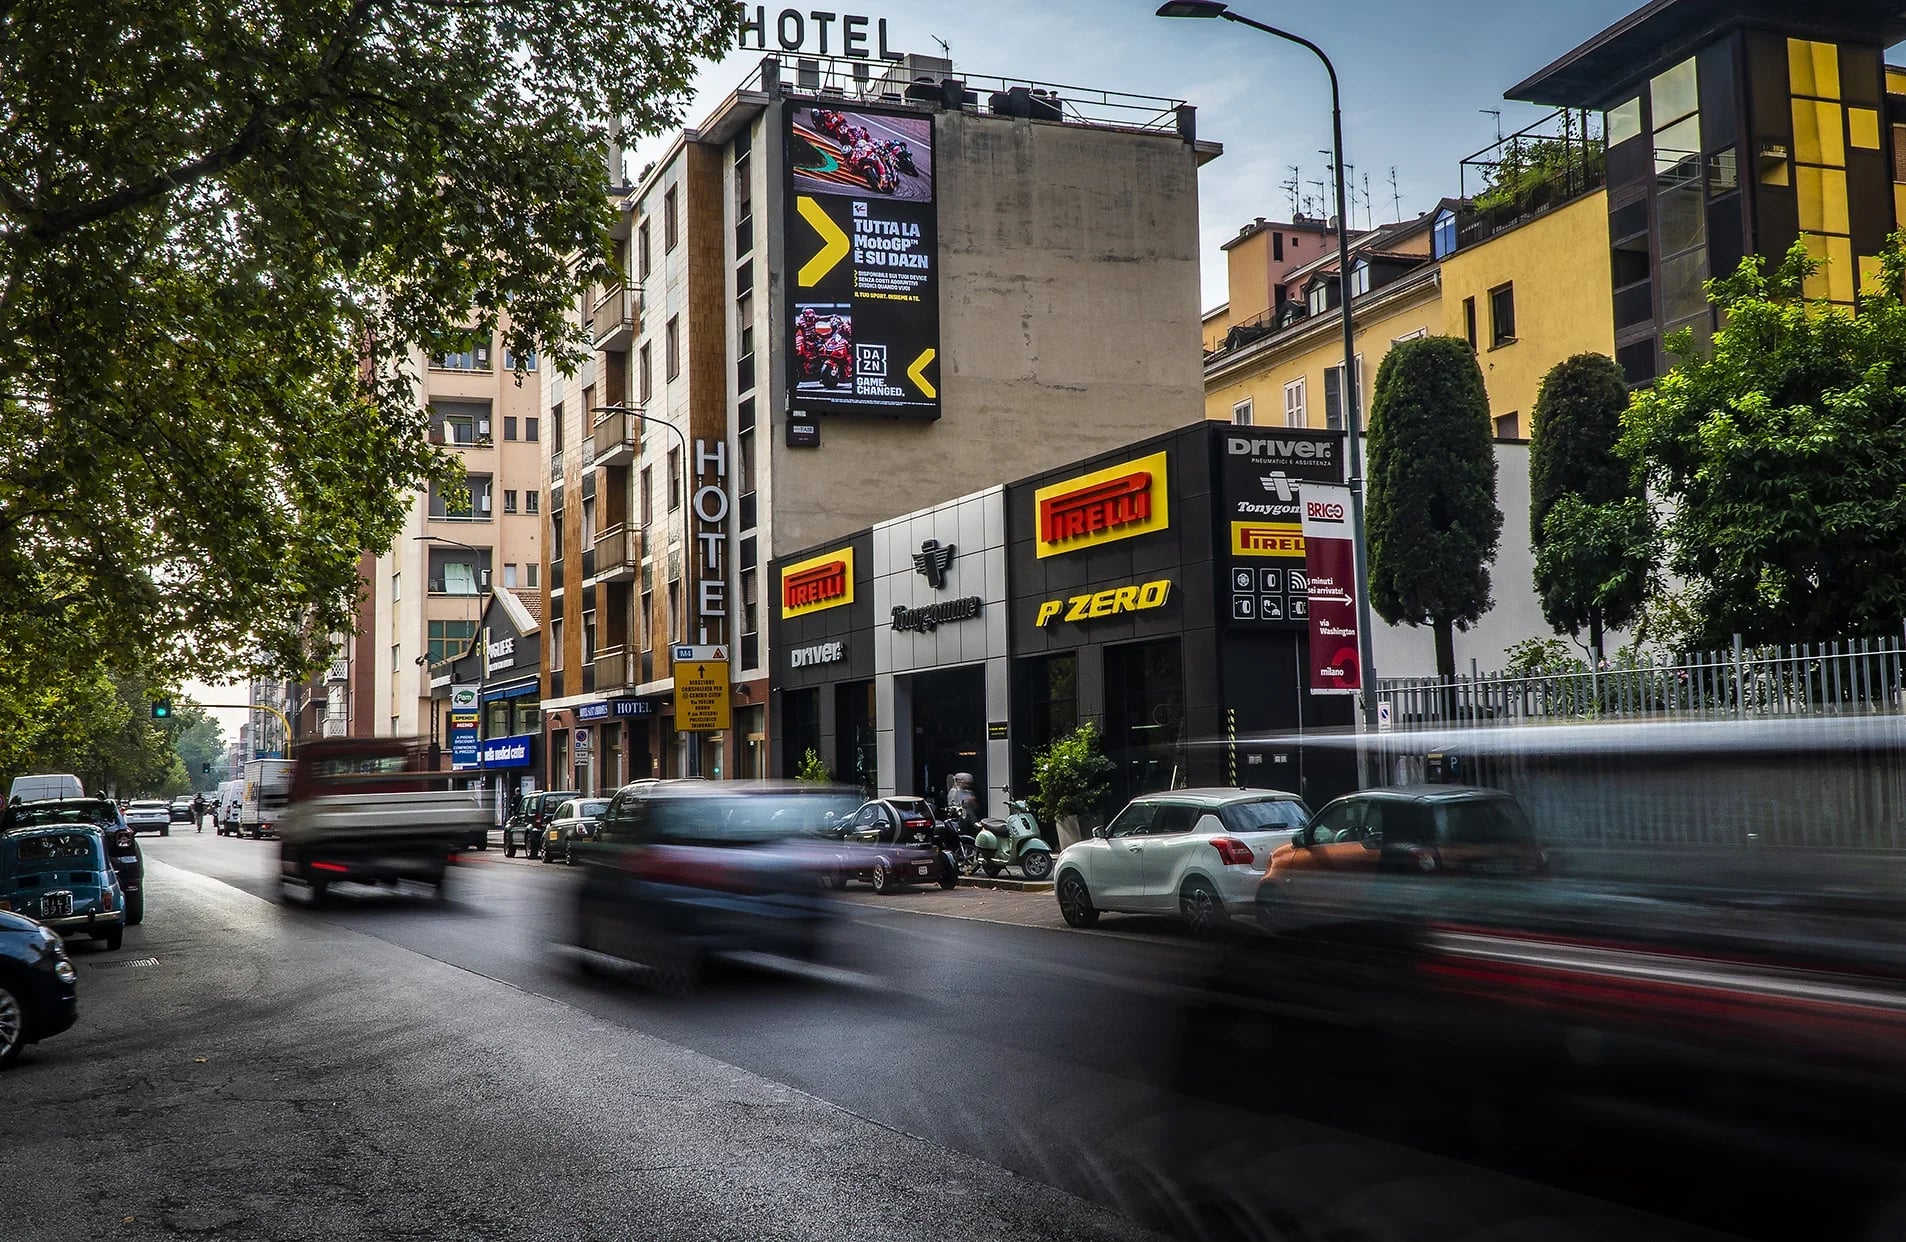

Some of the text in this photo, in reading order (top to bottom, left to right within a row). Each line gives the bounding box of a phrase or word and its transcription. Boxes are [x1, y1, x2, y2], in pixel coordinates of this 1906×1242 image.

[738, 4, 904, 61] HOTEL
[853, 218, 920, 237] TUTTA LA
[854, 247, 929, 269] È SU DAZN
[858, 270, 888, 278] DISPONIBILE
[856, 377, 887, 387] GAME.
[857, 385, 905, 397] CHANGED.
[1040, 471, 1152, 543] PIRELLI
[1237, 501, 1301, 516] Tonygom
[1240, 528, 1306, 551] PIREL
[784, 561, 846, 609] PIRELLI
[1311, 577, 1333, 585] minuti
[1307, 585, 1344, 595] sei arrivato!
[1035, 579, 1171, 627] P ZERO
[891, 595, 981, 634] Tonygomme
[1319, 619, 1330, 627] via
[1320, 627, 1355, 637] Washington
[1320, 667, 1344, 676] milano
[617, 702, 652, 714] HOTEL
[511, 744, 525, 759] center
[1450, 756, 1458, 769] P
